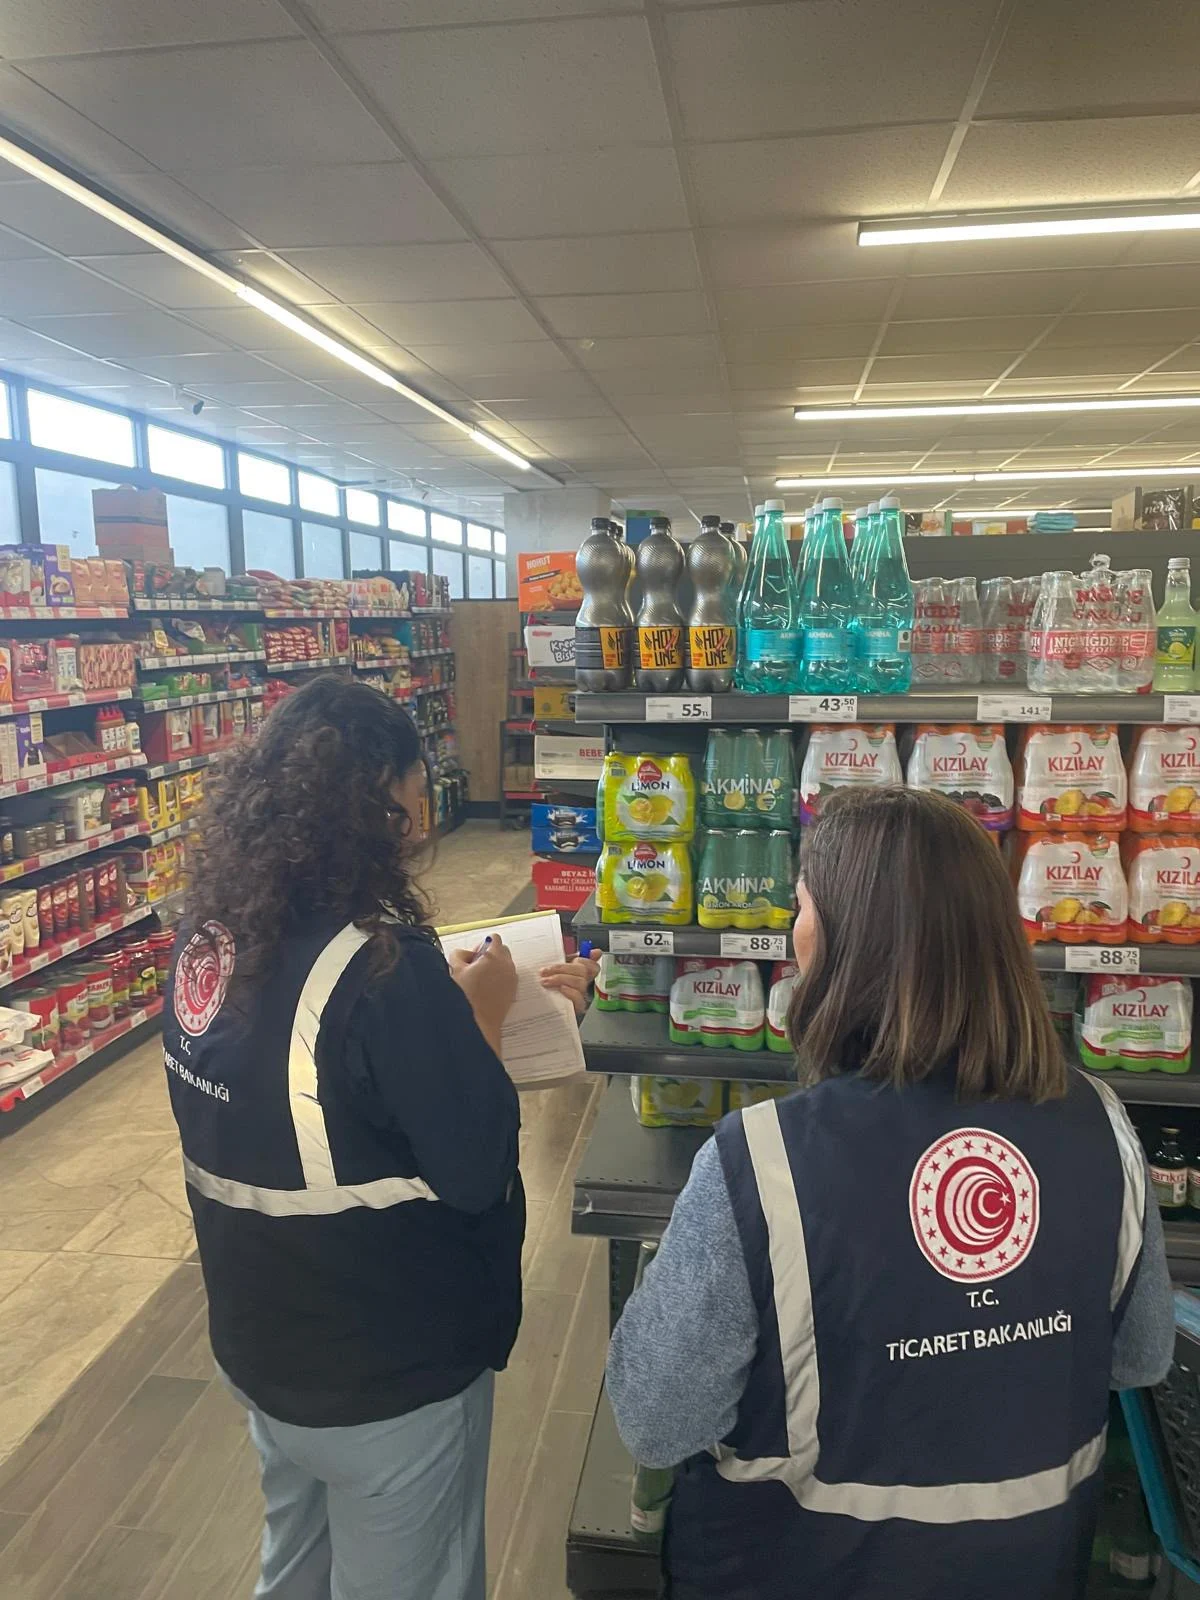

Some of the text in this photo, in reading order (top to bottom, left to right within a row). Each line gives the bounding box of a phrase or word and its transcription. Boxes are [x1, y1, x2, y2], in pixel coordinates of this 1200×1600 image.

[682, 704, 702, 717] 55
[825, 752, 878, 767] KIZILAY
[933, 757, 988, 771] KIZILAY
[1048, 755, 1104, 771] KIZILAY
[704, 774, 776, 795] AKMİNA
[1046, 865, 1103, 880] KIZILAY
[702, 872, 771, 894] AKMİNA
[644, 932, 664, 946] 62
[693, 981, 741, 996] KIZILAY
[1112, 1003, 1169, 1017] KIZILAY
[179, 1064, 230, 1103] BAKANLIĞI
[966, 1289, 1000, 1309] T.C.
[886, 1310, 1072, 1361] TİCARET BAKANLIĞI
